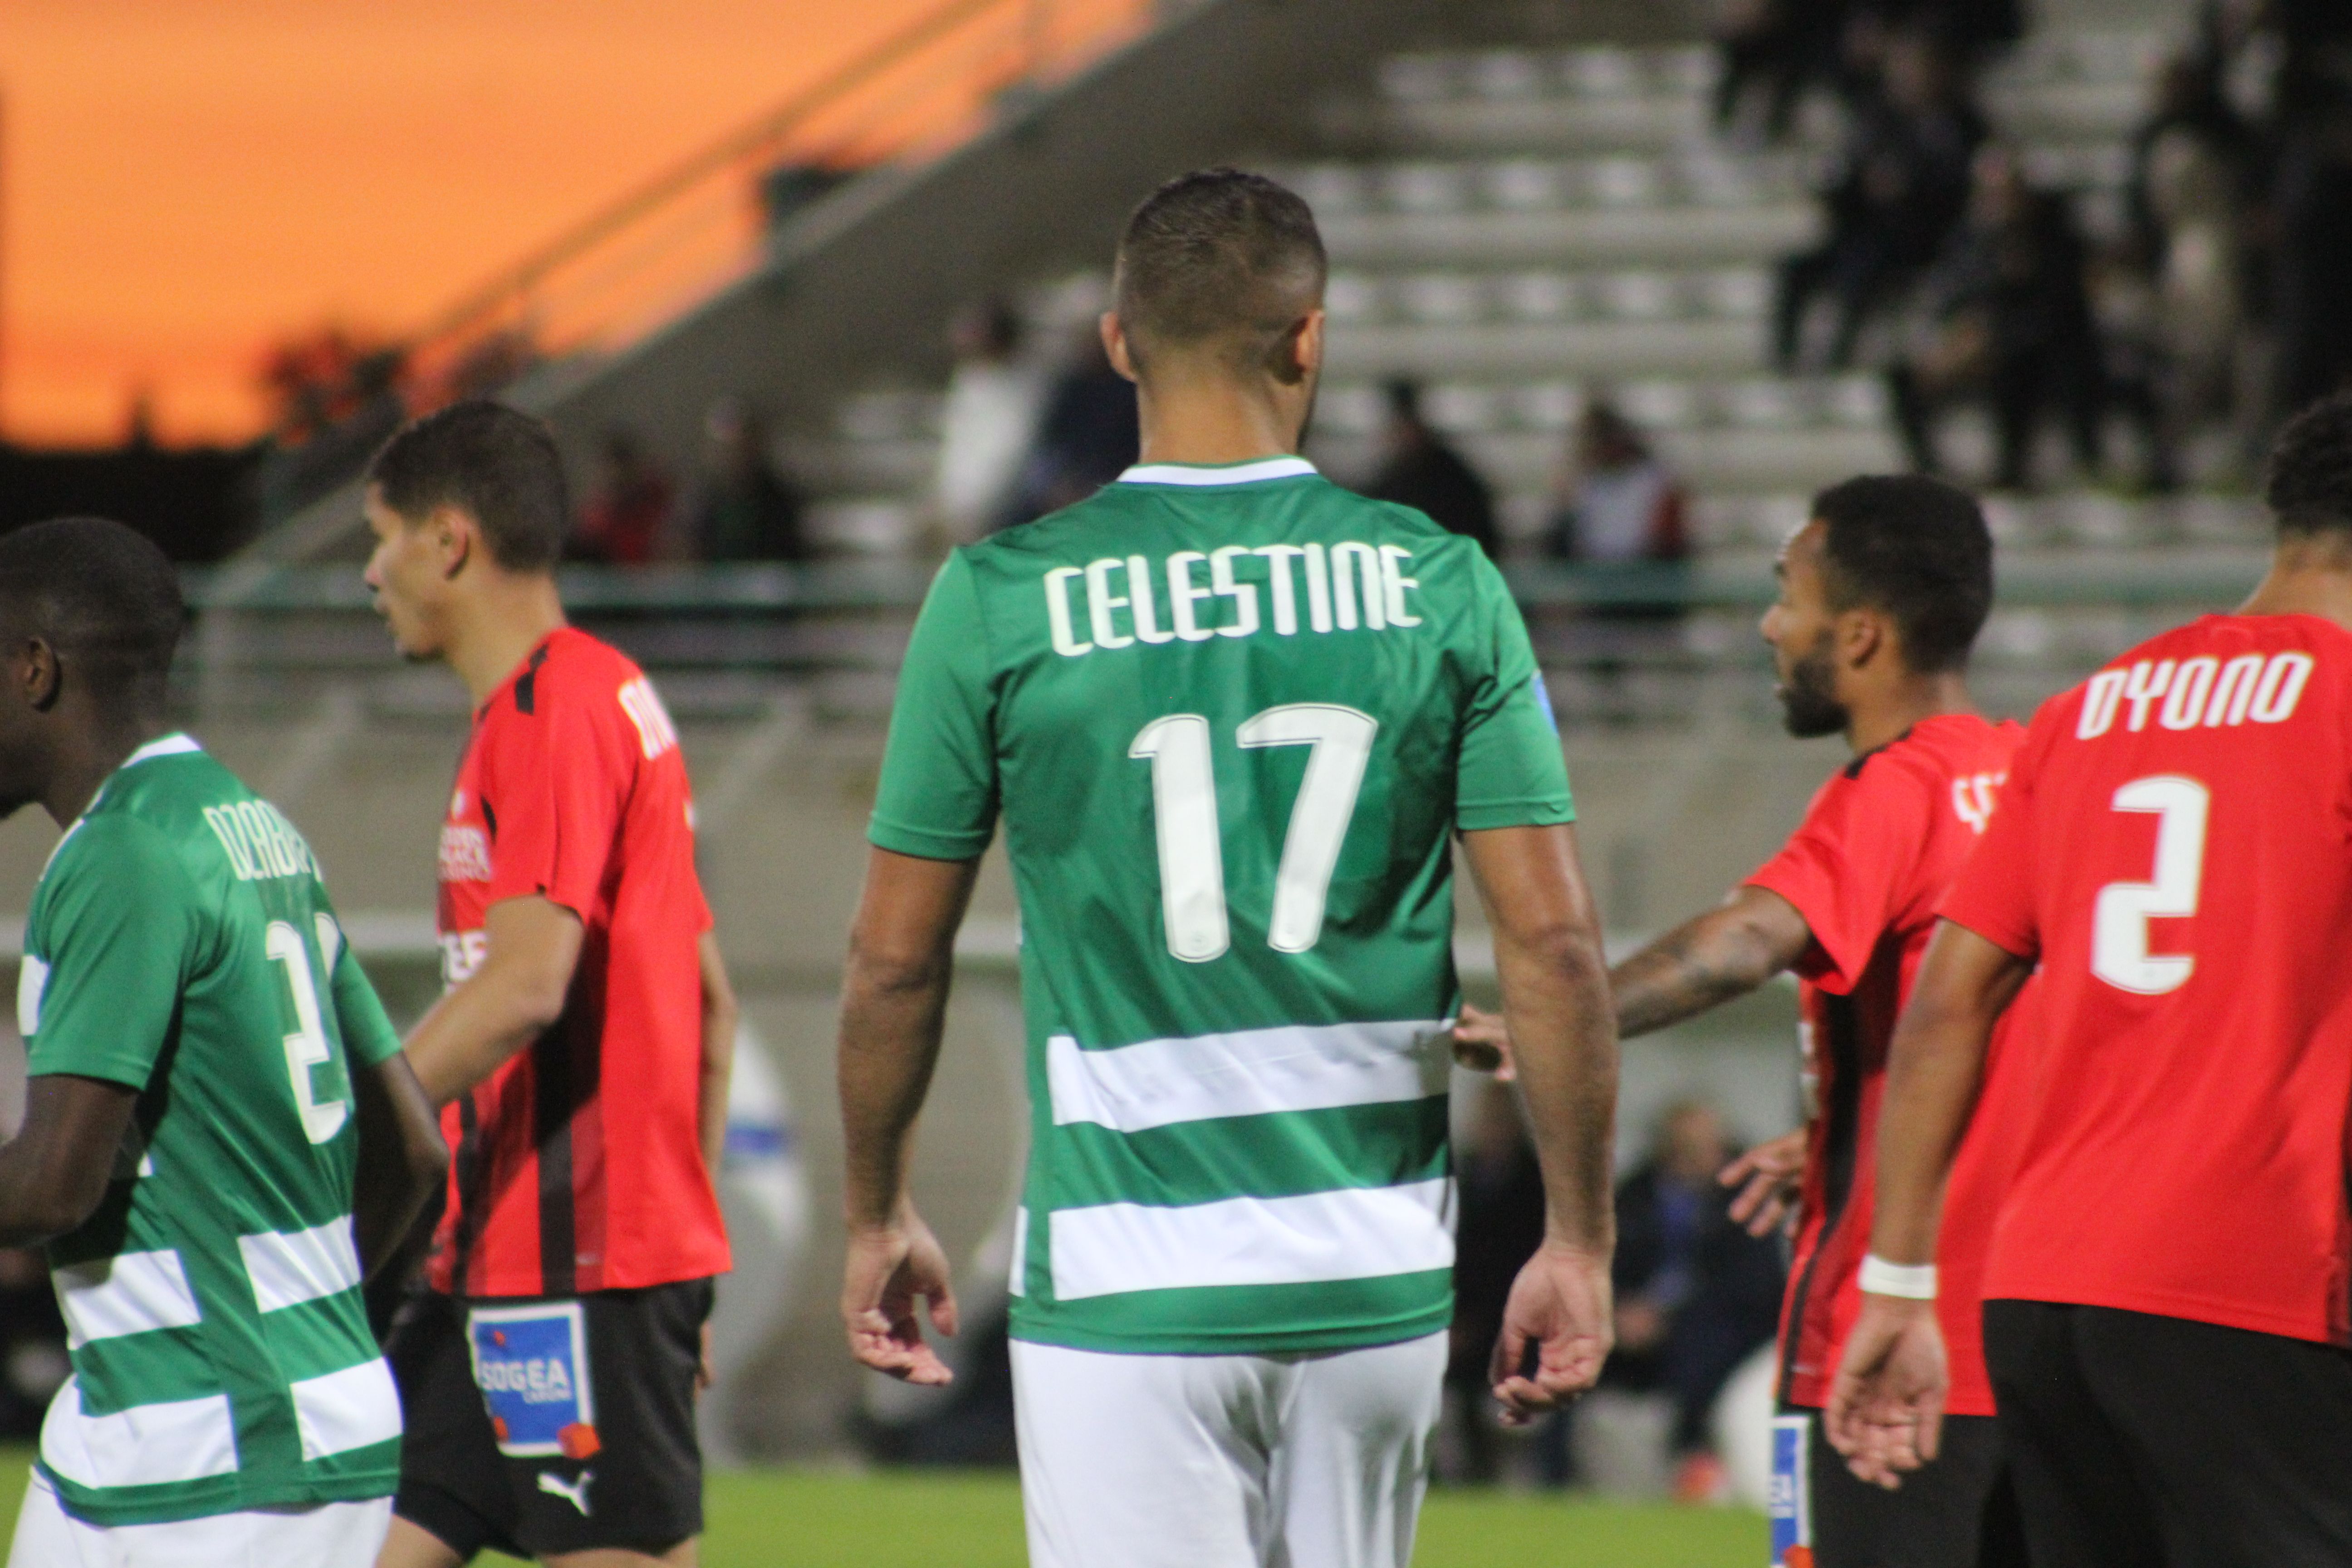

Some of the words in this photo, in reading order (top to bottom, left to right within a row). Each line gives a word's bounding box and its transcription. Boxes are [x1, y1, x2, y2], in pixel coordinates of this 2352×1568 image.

[1044, 541, 1422, 657] CELESTINE
[2075, 650, 2314, 740] DYONO
[1128, 702, 1378, 962] 17
[2090, 774, 2211, 995] 2
[479, 1358, 570, 1392] SOGEA
